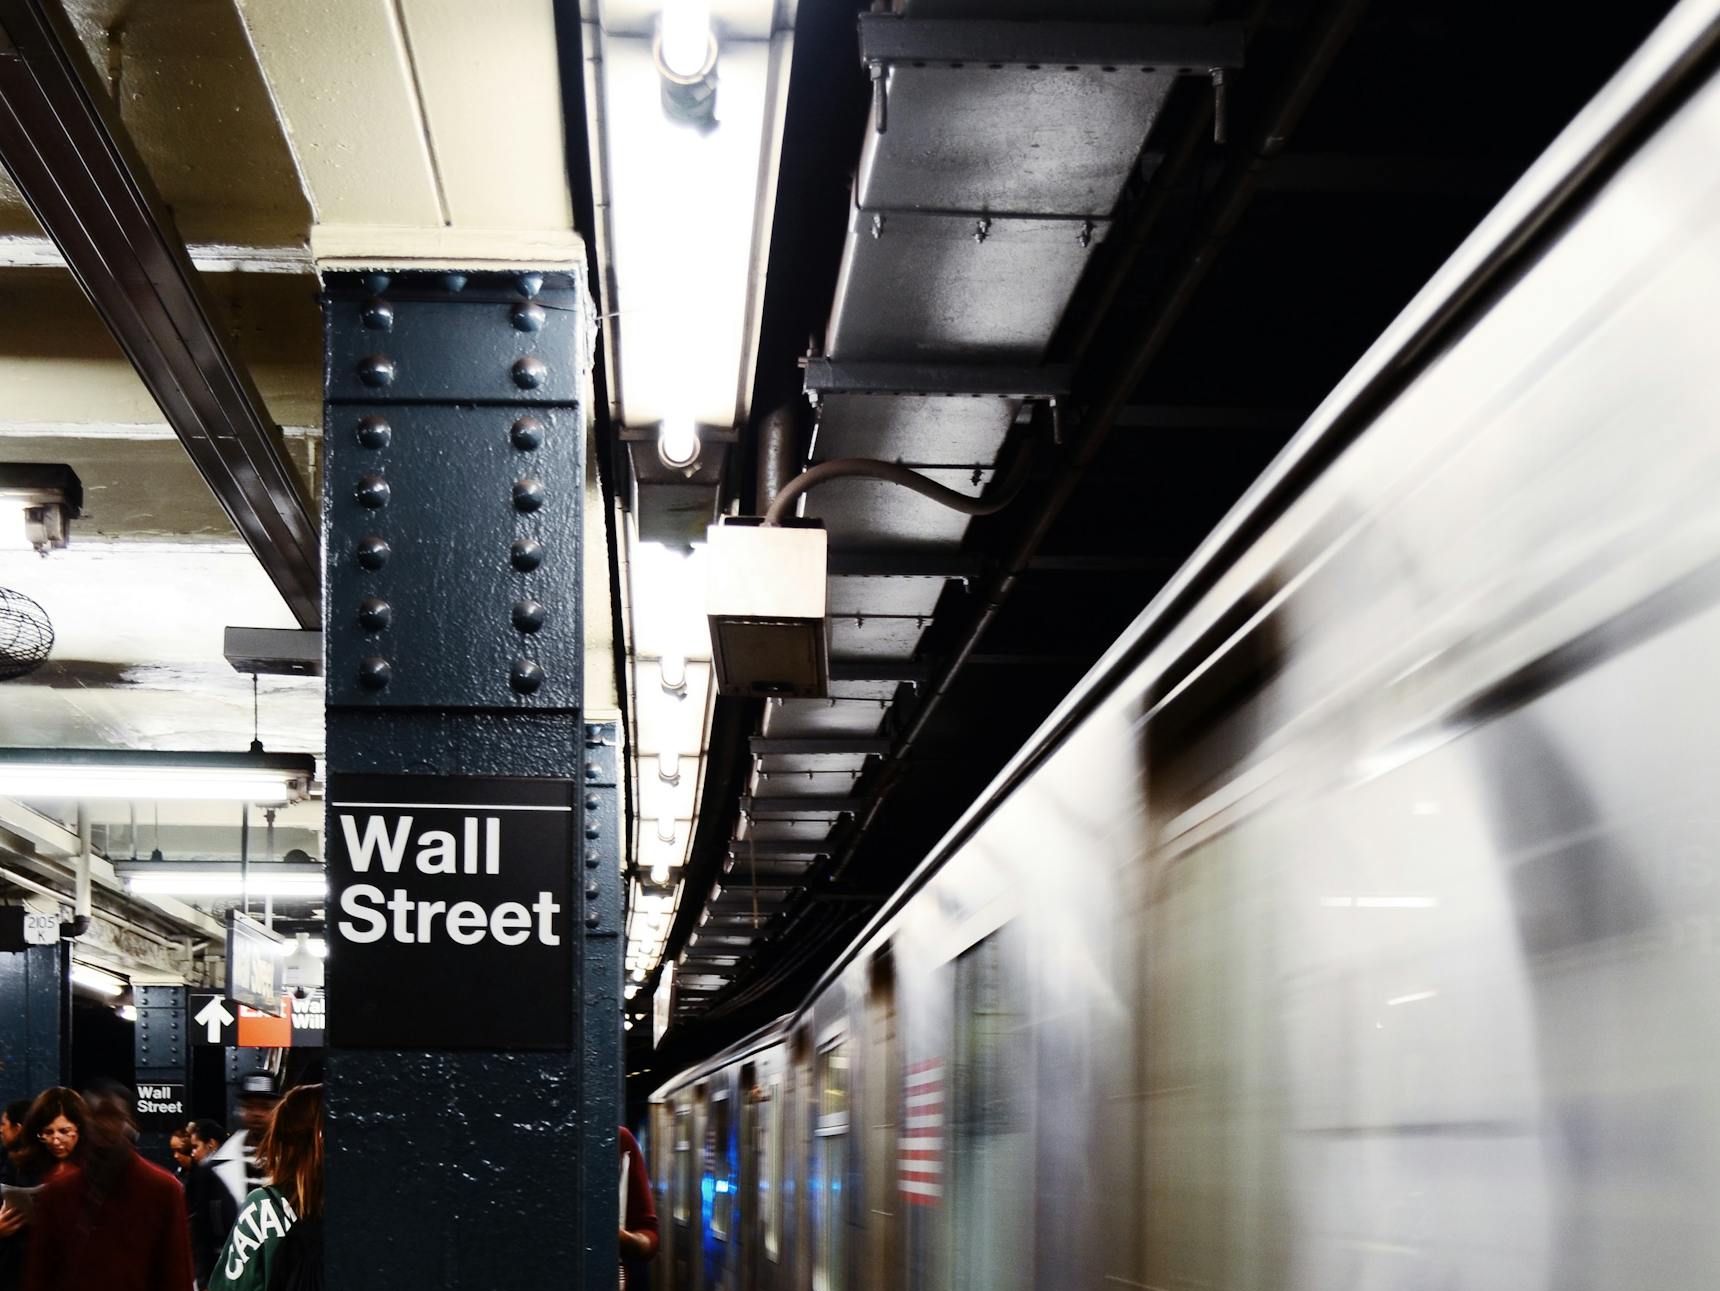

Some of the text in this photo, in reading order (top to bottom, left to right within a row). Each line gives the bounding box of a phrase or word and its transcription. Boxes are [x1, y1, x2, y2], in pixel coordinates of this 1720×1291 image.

[340, 815, 500, 875] Wall
[338, 884, 561, 946] Street
[28, 916, 56, 929] 2105
[137, 1086, 171, 1099] Wall
[137, 1100, 183, 1113] Street
